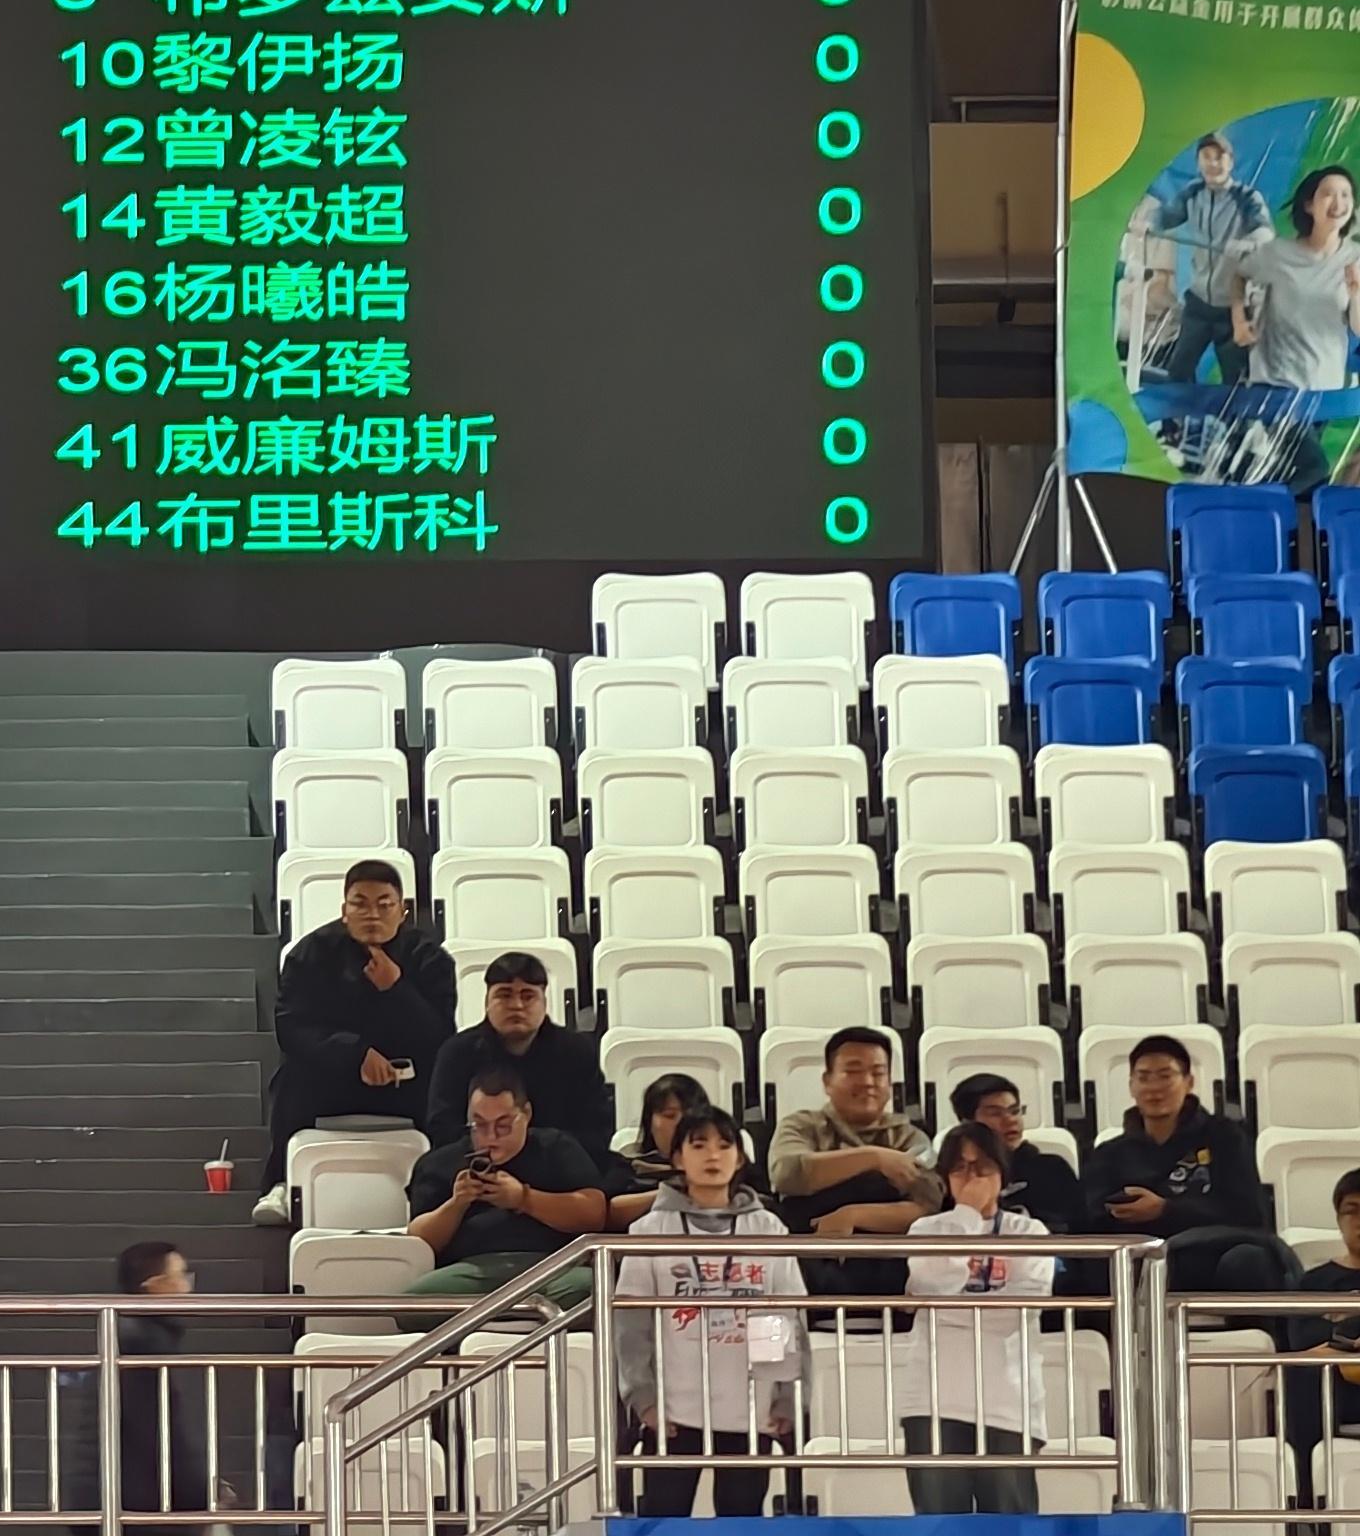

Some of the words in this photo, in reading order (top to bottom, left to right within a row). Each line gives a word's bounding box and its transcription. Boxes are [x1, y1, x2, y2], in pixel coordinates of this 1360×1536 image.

[813, 33, 862, 84] 0
[816, 108, 864, 161] 0
[817, 186, 865, 236] 0
[818, 263, 868, 313] 0
[819, 339, 868, 391] 0
[821, 416, 872, 468] 0
[823, 494, 873, 547] 0
